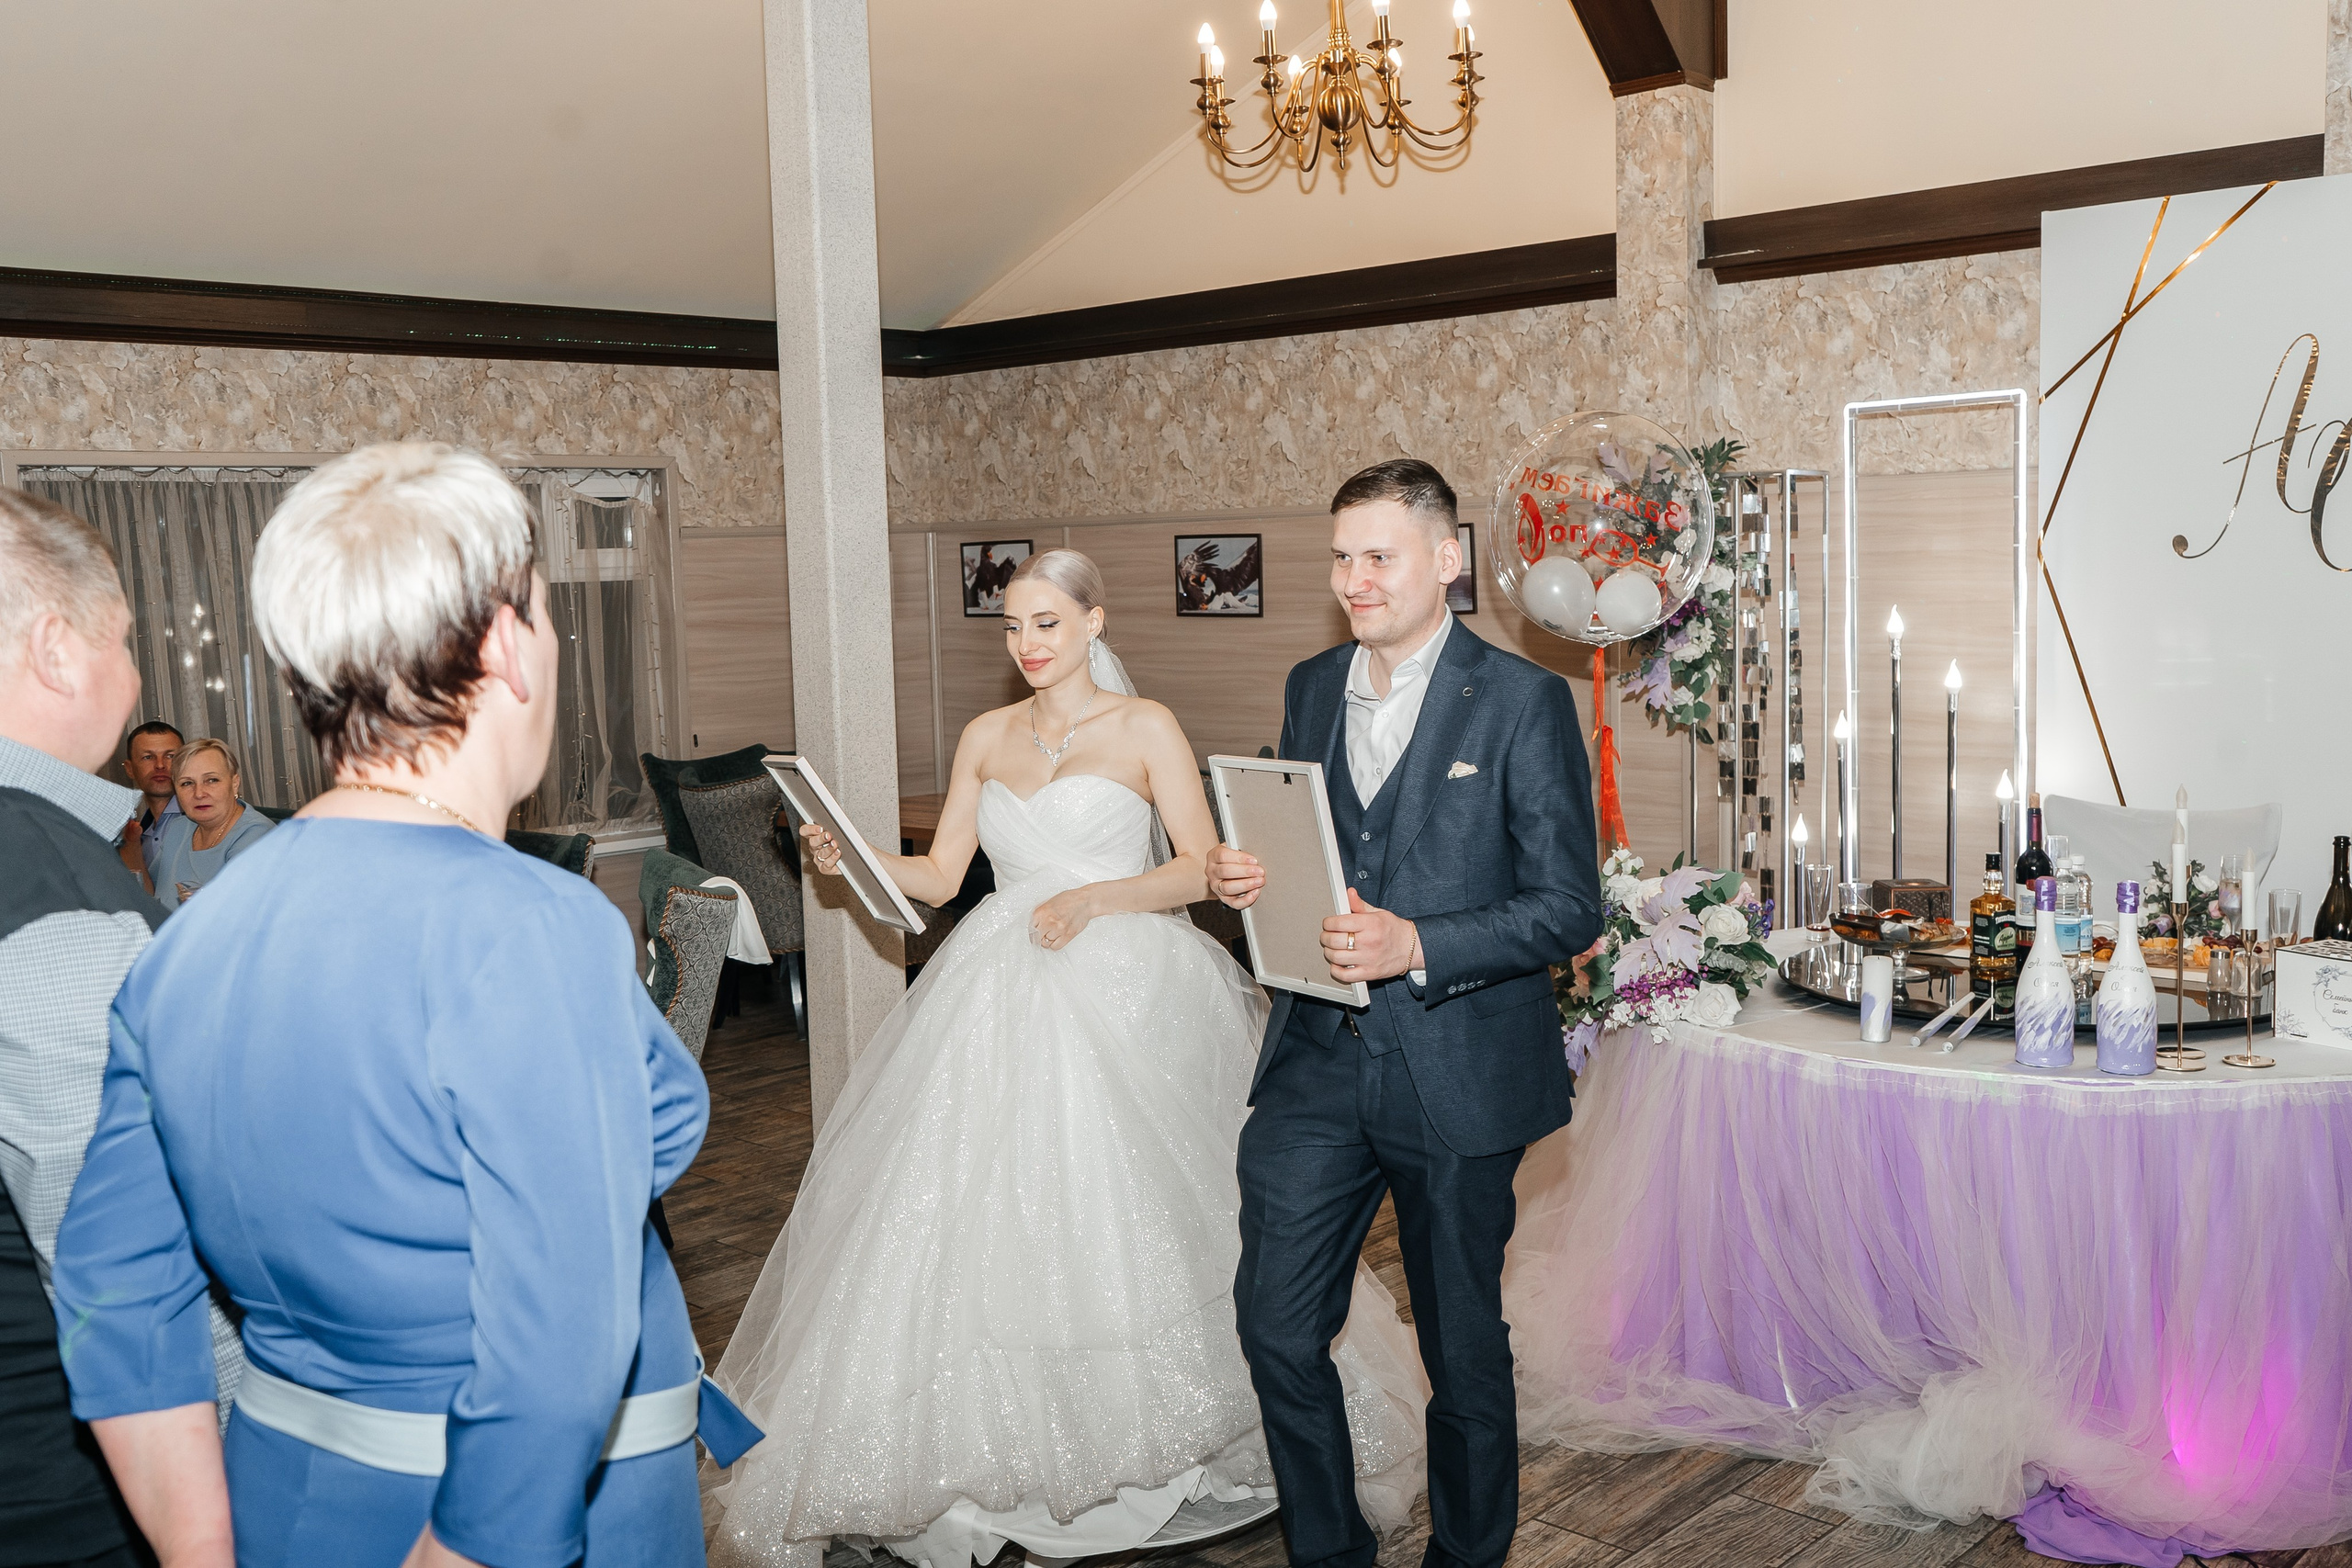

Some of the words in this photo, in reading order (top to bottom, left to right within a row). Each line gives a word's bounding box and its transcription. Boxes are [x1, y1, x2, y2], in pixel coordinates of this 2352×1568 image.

[2027, 957, 2064, 969] Аксей
[2107, 961, 2144, 974] Алксей
[2323, 988, 2352, 1002] Семейн
